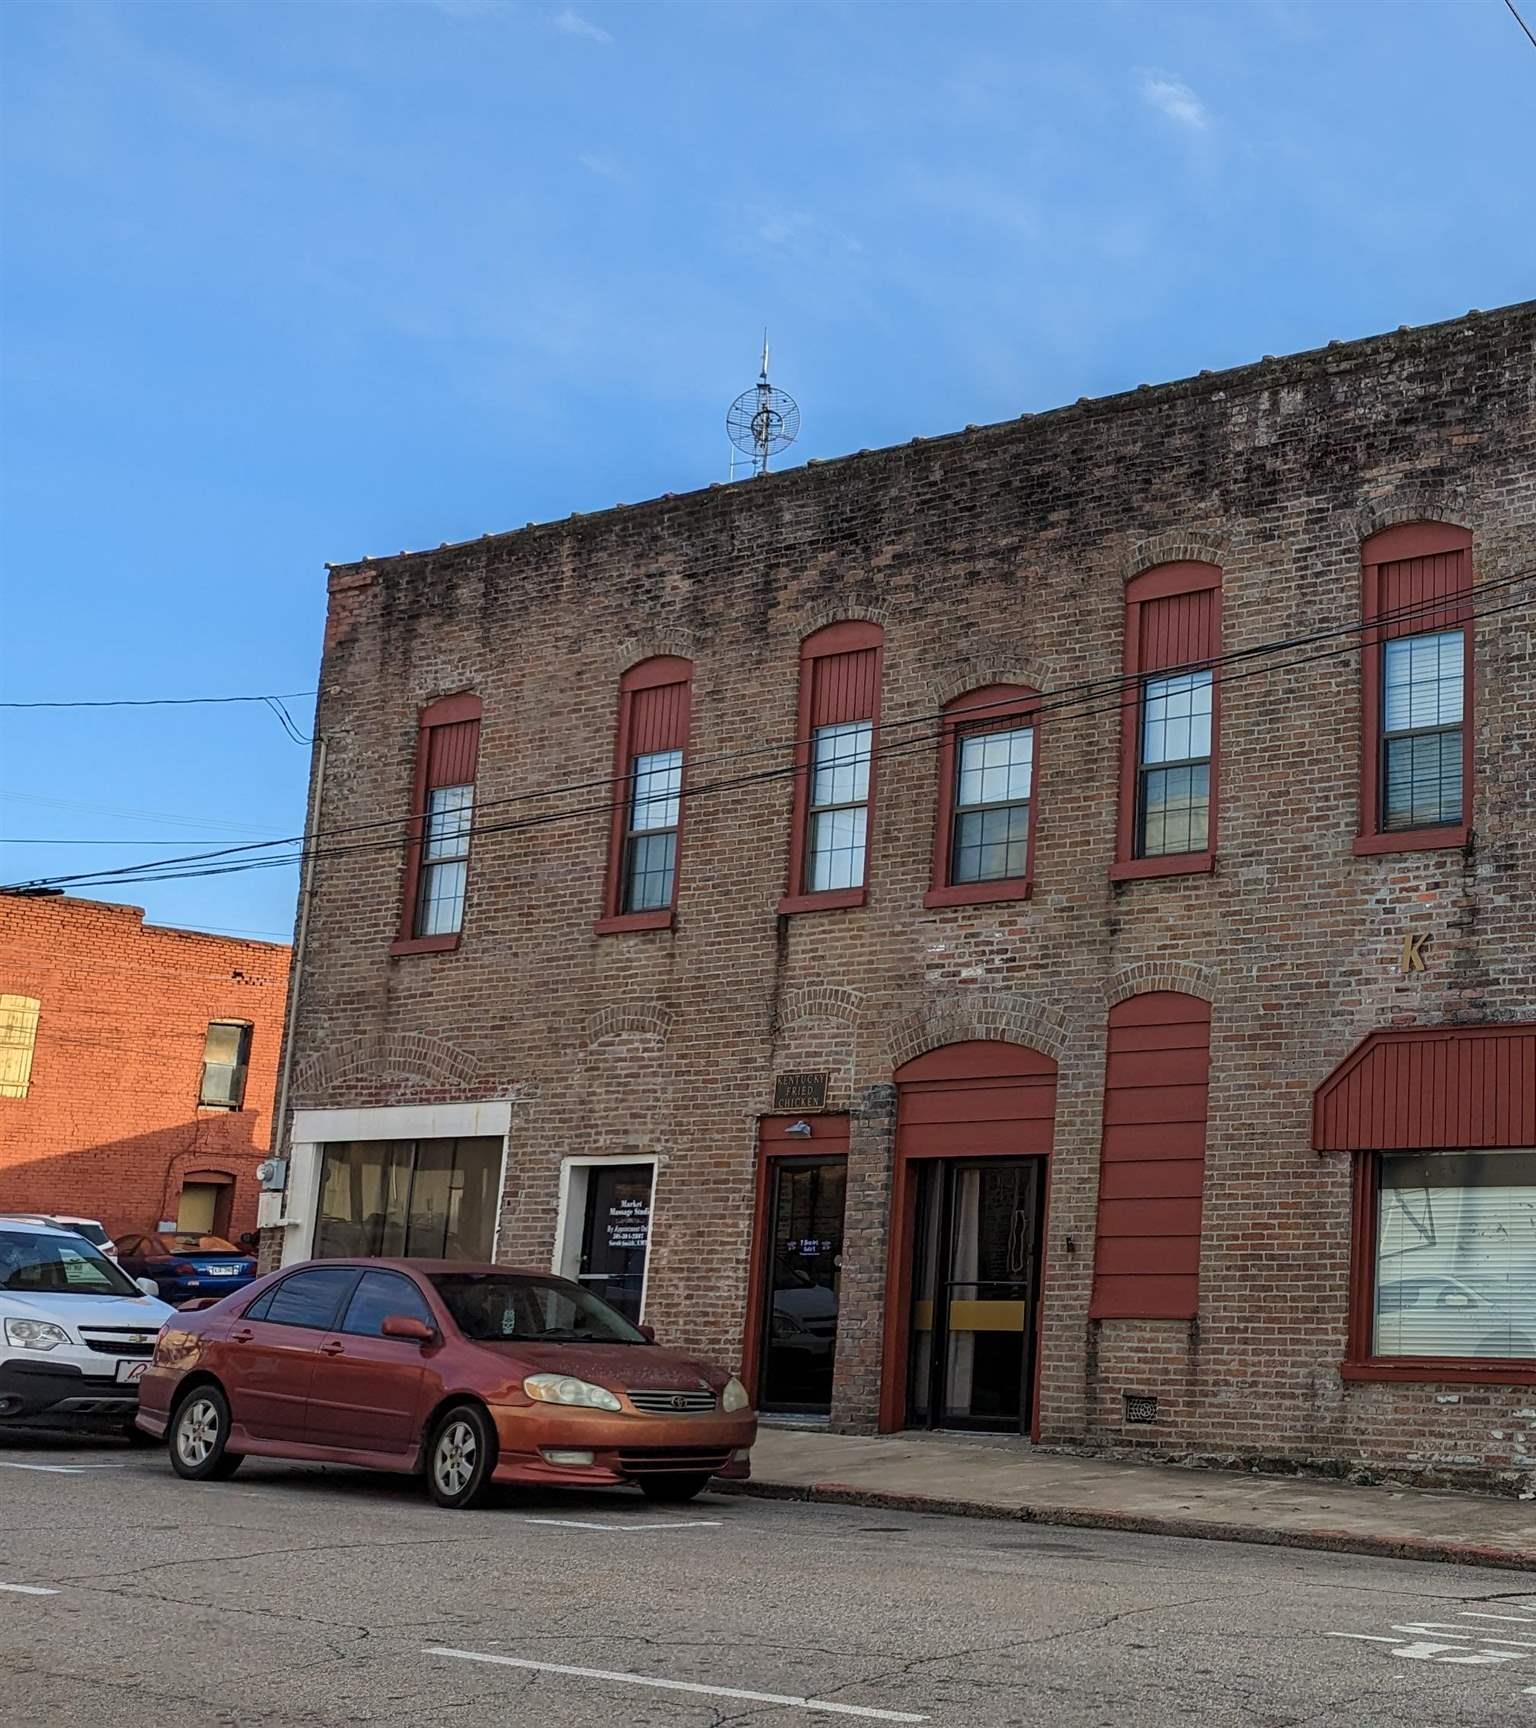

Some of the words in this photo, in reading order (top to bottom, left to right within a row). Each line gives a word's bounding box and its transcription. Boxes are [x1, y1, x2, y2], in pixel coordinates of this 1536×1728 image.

[1402, 931, 1429, 973] K
[777, 1074, 825, 1085] KENTUCKY
[786, 1086, 814, 1096] FRIED
[778, 1097, 819, 1108] CHICKEN
